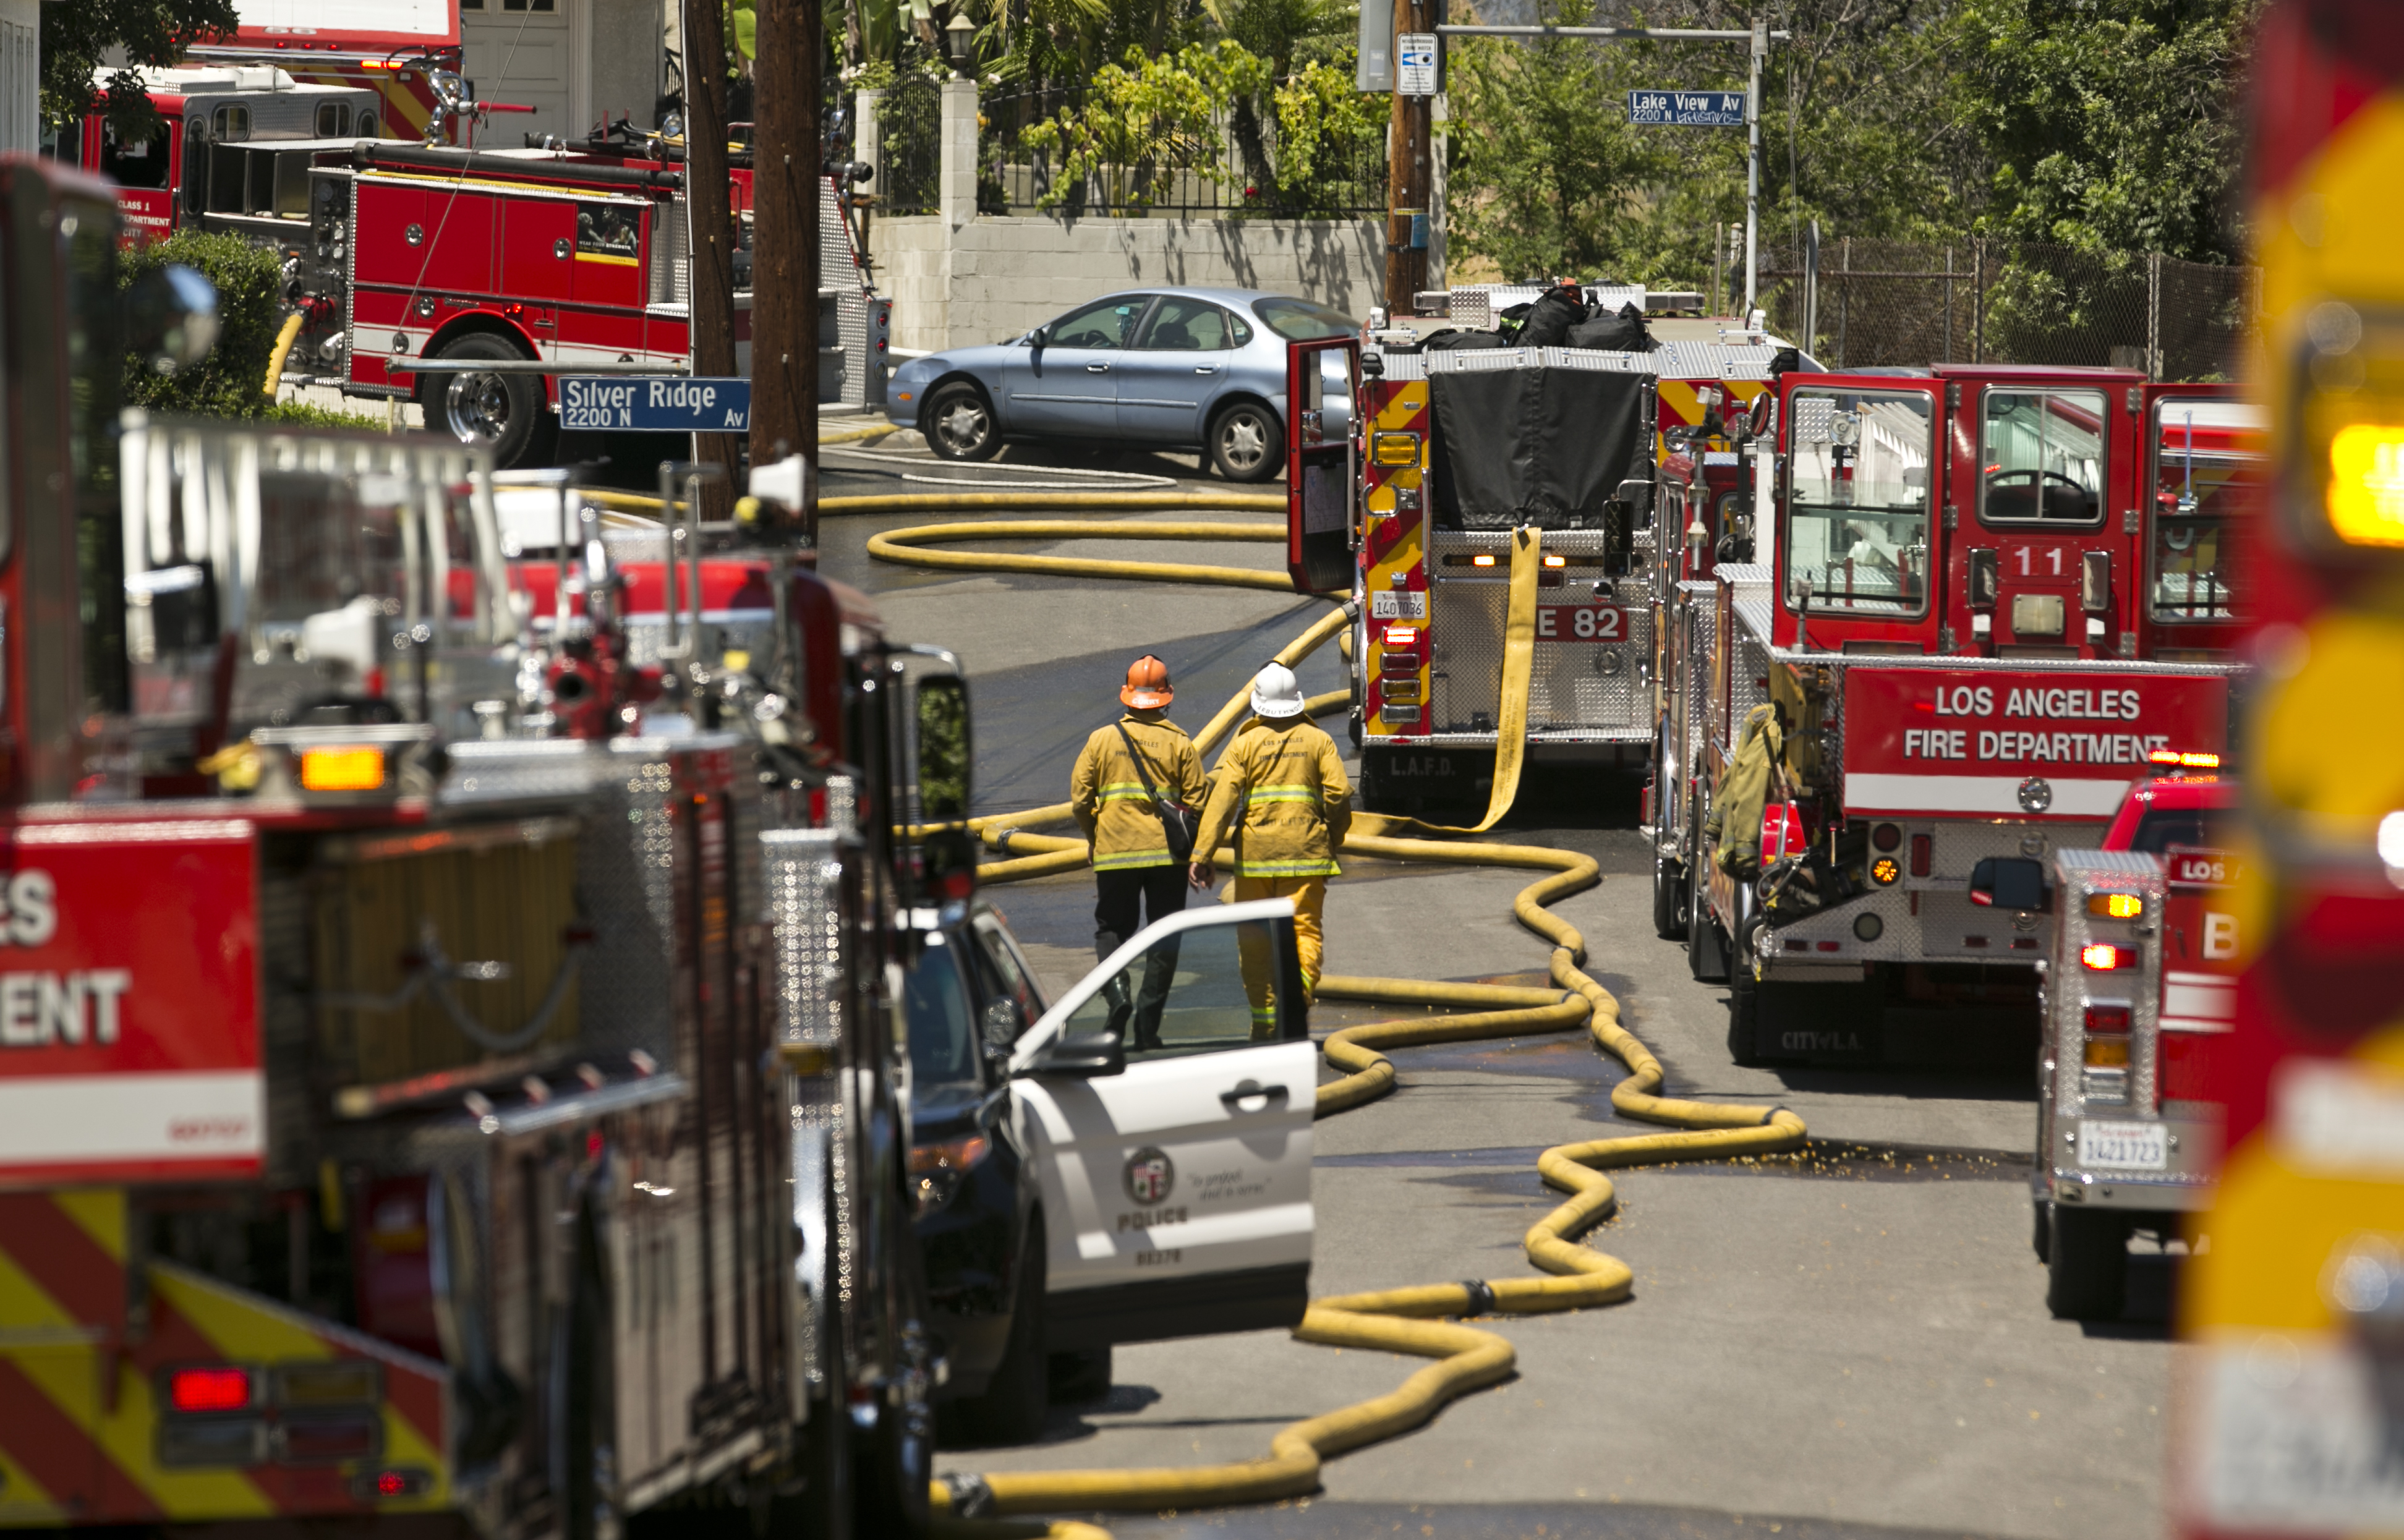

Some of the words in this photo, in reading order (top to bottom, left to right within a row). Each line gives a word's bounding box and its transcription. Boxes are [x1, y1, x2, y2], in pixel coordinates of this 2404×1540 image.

[1633, 93, 1666, 110] Lake
[1675, 94, 1708, 111] View
[1721, 95, 1739, 111] Av
[1632, 109, 1660, 121] 2200
[1665, 110, 1671, 121] N
[117, 200, 142, 210] CLASS
[145, 202, 150, 211] 1
[567, 381, 636, 408] Silver
[649, 381, 715, 415] Ridge
[566, 408, 612, 426] 2200
[620, 408, 631, 427] N
[724, 409, 744, 427] Av
[1376, 602, 1422, 615] 1407036
[1539, 609, 1557, 636] E
[1574, 608, 1619, 637] 82
[1936, 686, 1993, 717] LOS
[2005, 689, 2141, 720] ANGELES
[1904, 729, 1966, 759] FIRE
[1391, 757, 1456, 776] L.A.F.D.
[2181, 860, 2225, 882] LOS
[2203, 912, 2240, 960] B
[1782, 1032, 1820, 1050] CITY
[1117, 1207, 1188, 1233] POLICE
